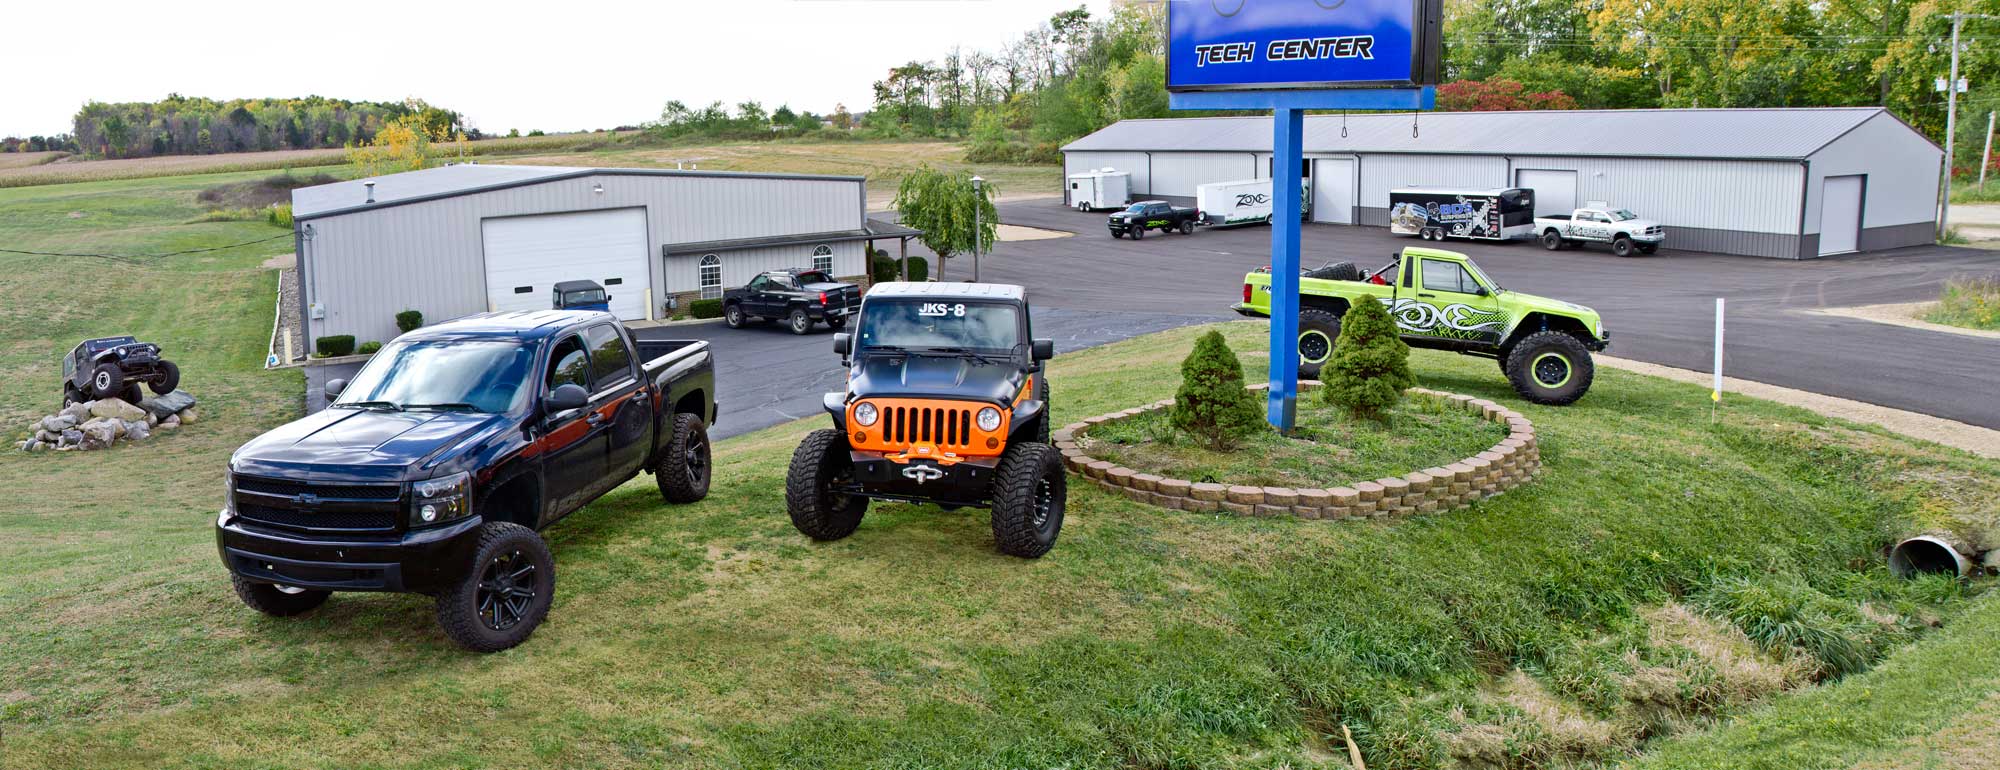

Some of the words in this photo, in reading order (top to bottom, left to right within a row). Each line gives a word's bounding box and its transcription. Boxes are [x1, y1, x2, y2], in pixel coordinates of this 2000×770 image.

[1196, 42, 1256, 67] TECH
[1266, 35, 1374, 60] CENTER
[1236, 193, 1271, 208] ZONE
[1440, 203, 1473, 215] BDS
[918, 303, 966, 317] JKS-8
